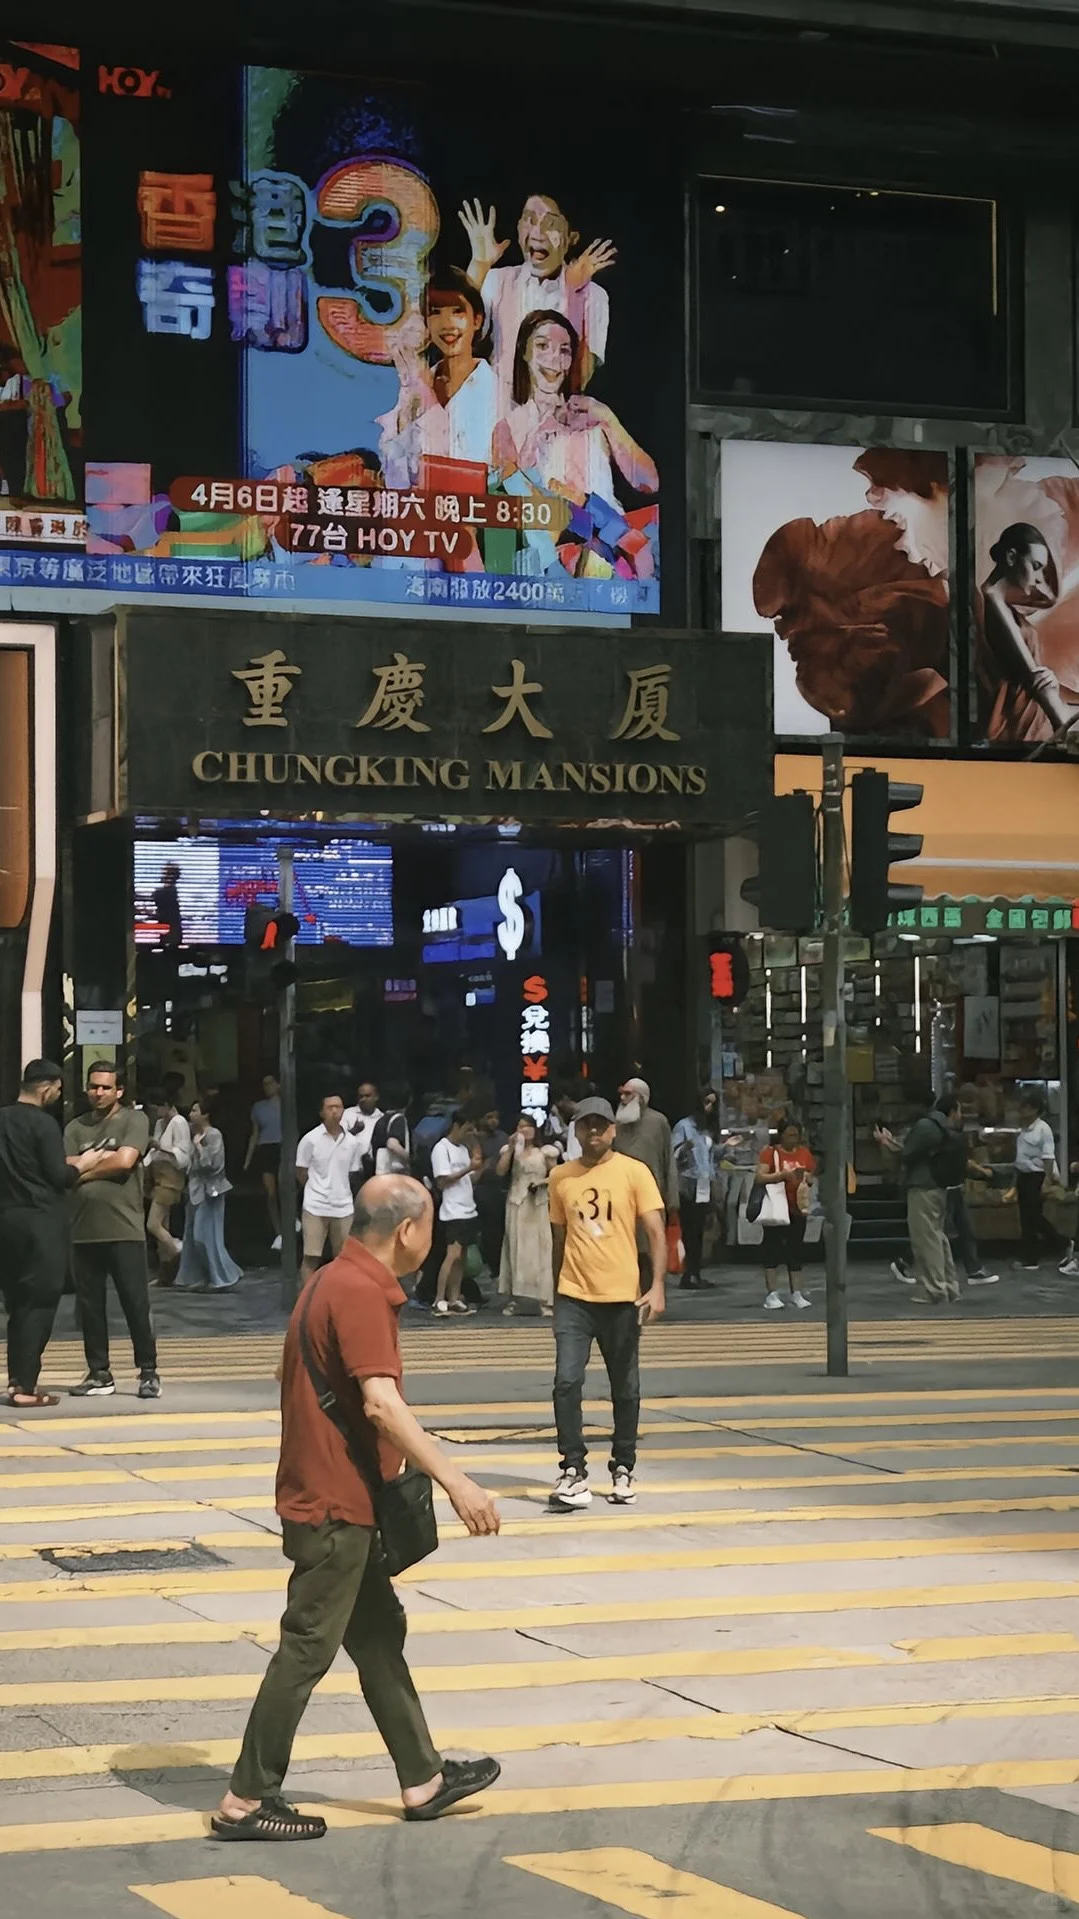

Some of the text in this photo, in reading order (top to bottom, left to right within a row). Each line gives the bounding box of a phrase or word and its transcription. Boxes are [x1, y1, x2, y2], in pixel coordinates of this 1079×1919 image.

[190, 482, 308, 513] 4月6日起
[434, 495, 487, 524] 晚上
[496, 500, 551, 525] 8:30
[290, 521, 459, 553] 77台 HOY TV
[192, 750, 708, 796] CHUNGKING MANSIONS
